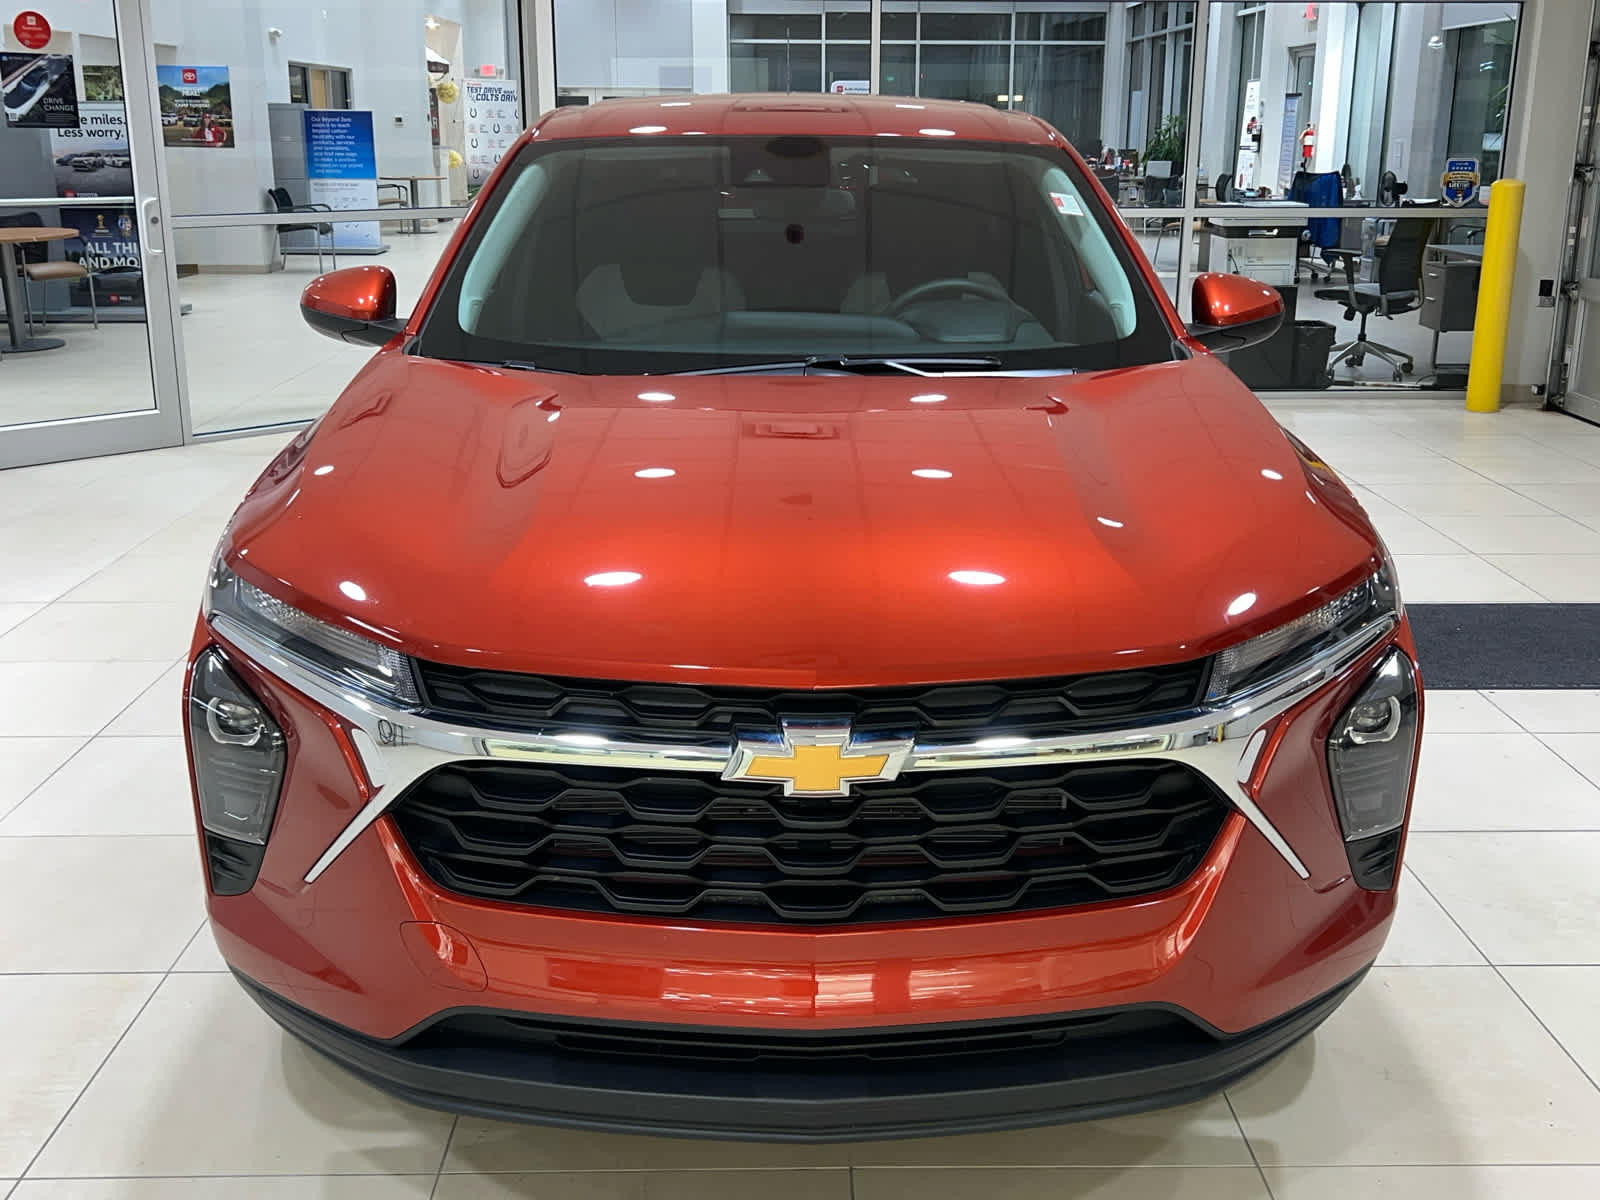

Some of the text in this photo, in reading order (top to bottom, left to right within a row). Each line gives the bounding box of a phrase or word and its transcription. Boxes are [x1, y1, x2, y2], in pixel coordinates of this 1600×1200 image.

[475, 93, 499, 102] COLTS
[57, 128, 124, 140] Less worry.
[86, 242, 111, 254] ALL
[79, 256, 141, 269] AND MO
